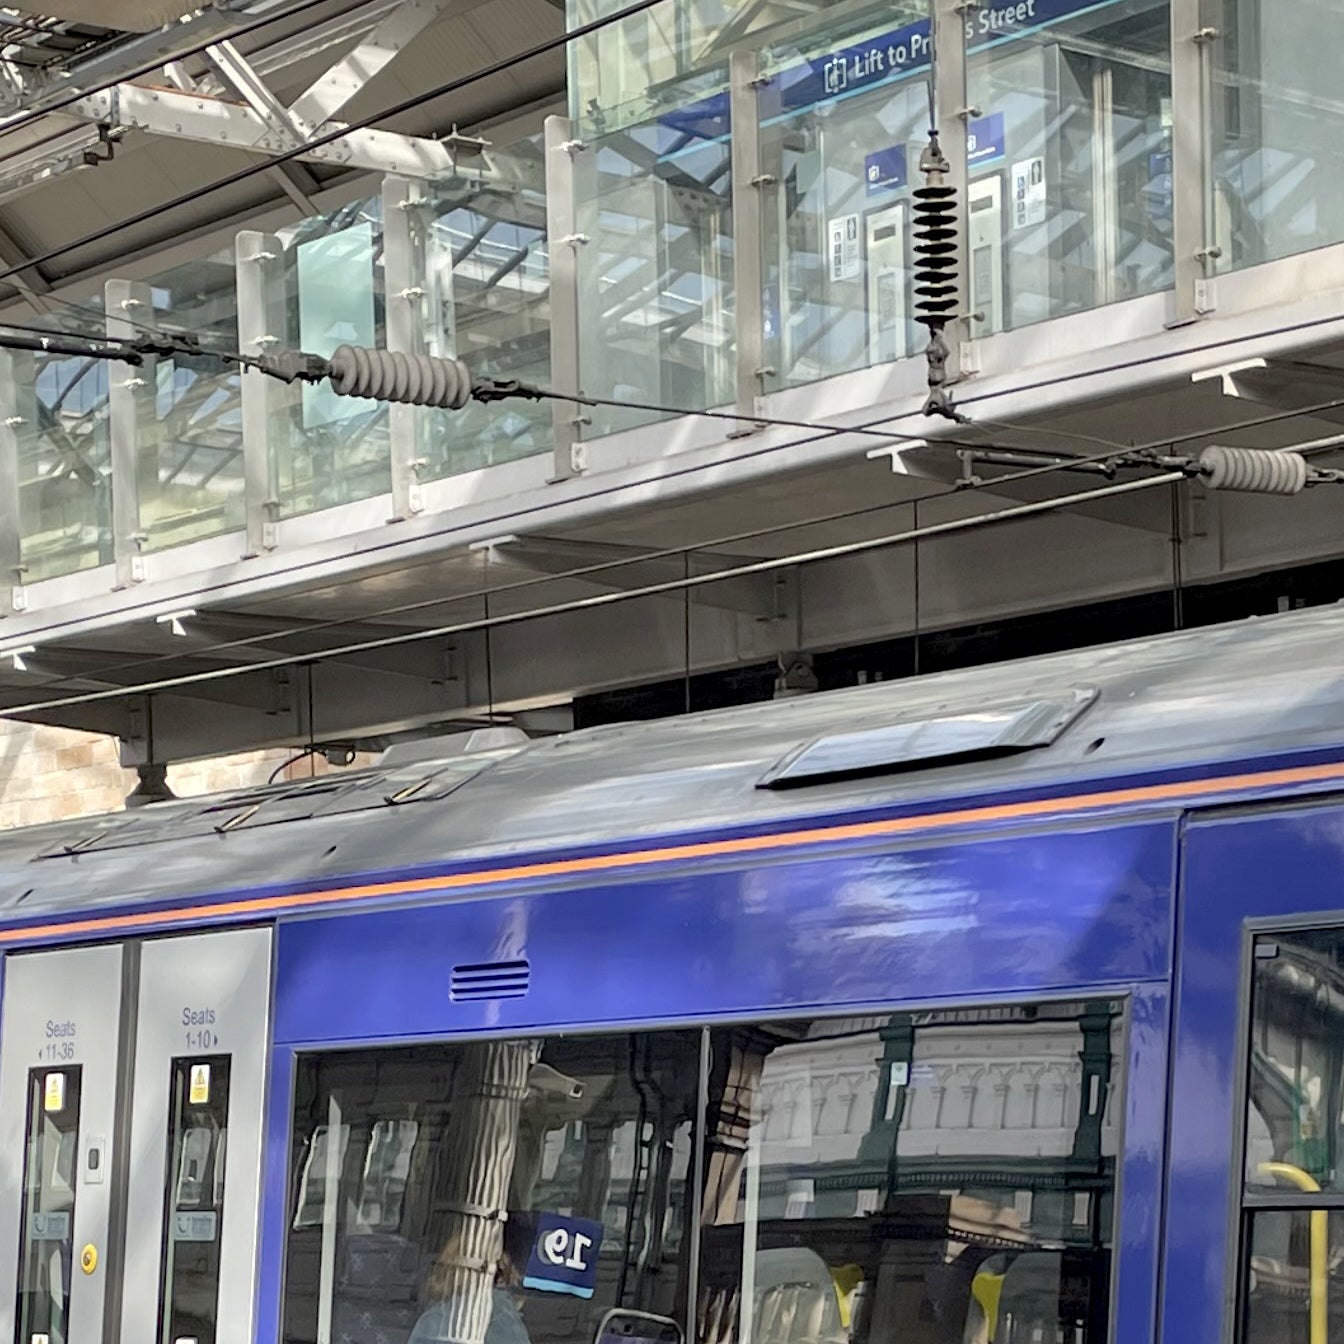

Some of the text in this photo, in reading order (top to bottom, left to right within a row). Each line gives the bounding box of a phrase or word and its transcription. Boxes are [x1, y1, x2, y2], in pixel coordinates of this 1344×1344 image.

[854, 48, 884, 79] Lift
[887, 45, 907, 67] to
[978, 0, 1036, 35] Street
[182, 1007, 216, 1026] Seats
[45, 1020, 76, 1038] Seats
[185, 1030, 210, 1049] 1-10
[46, 1042, 74, 1061] 11-36
